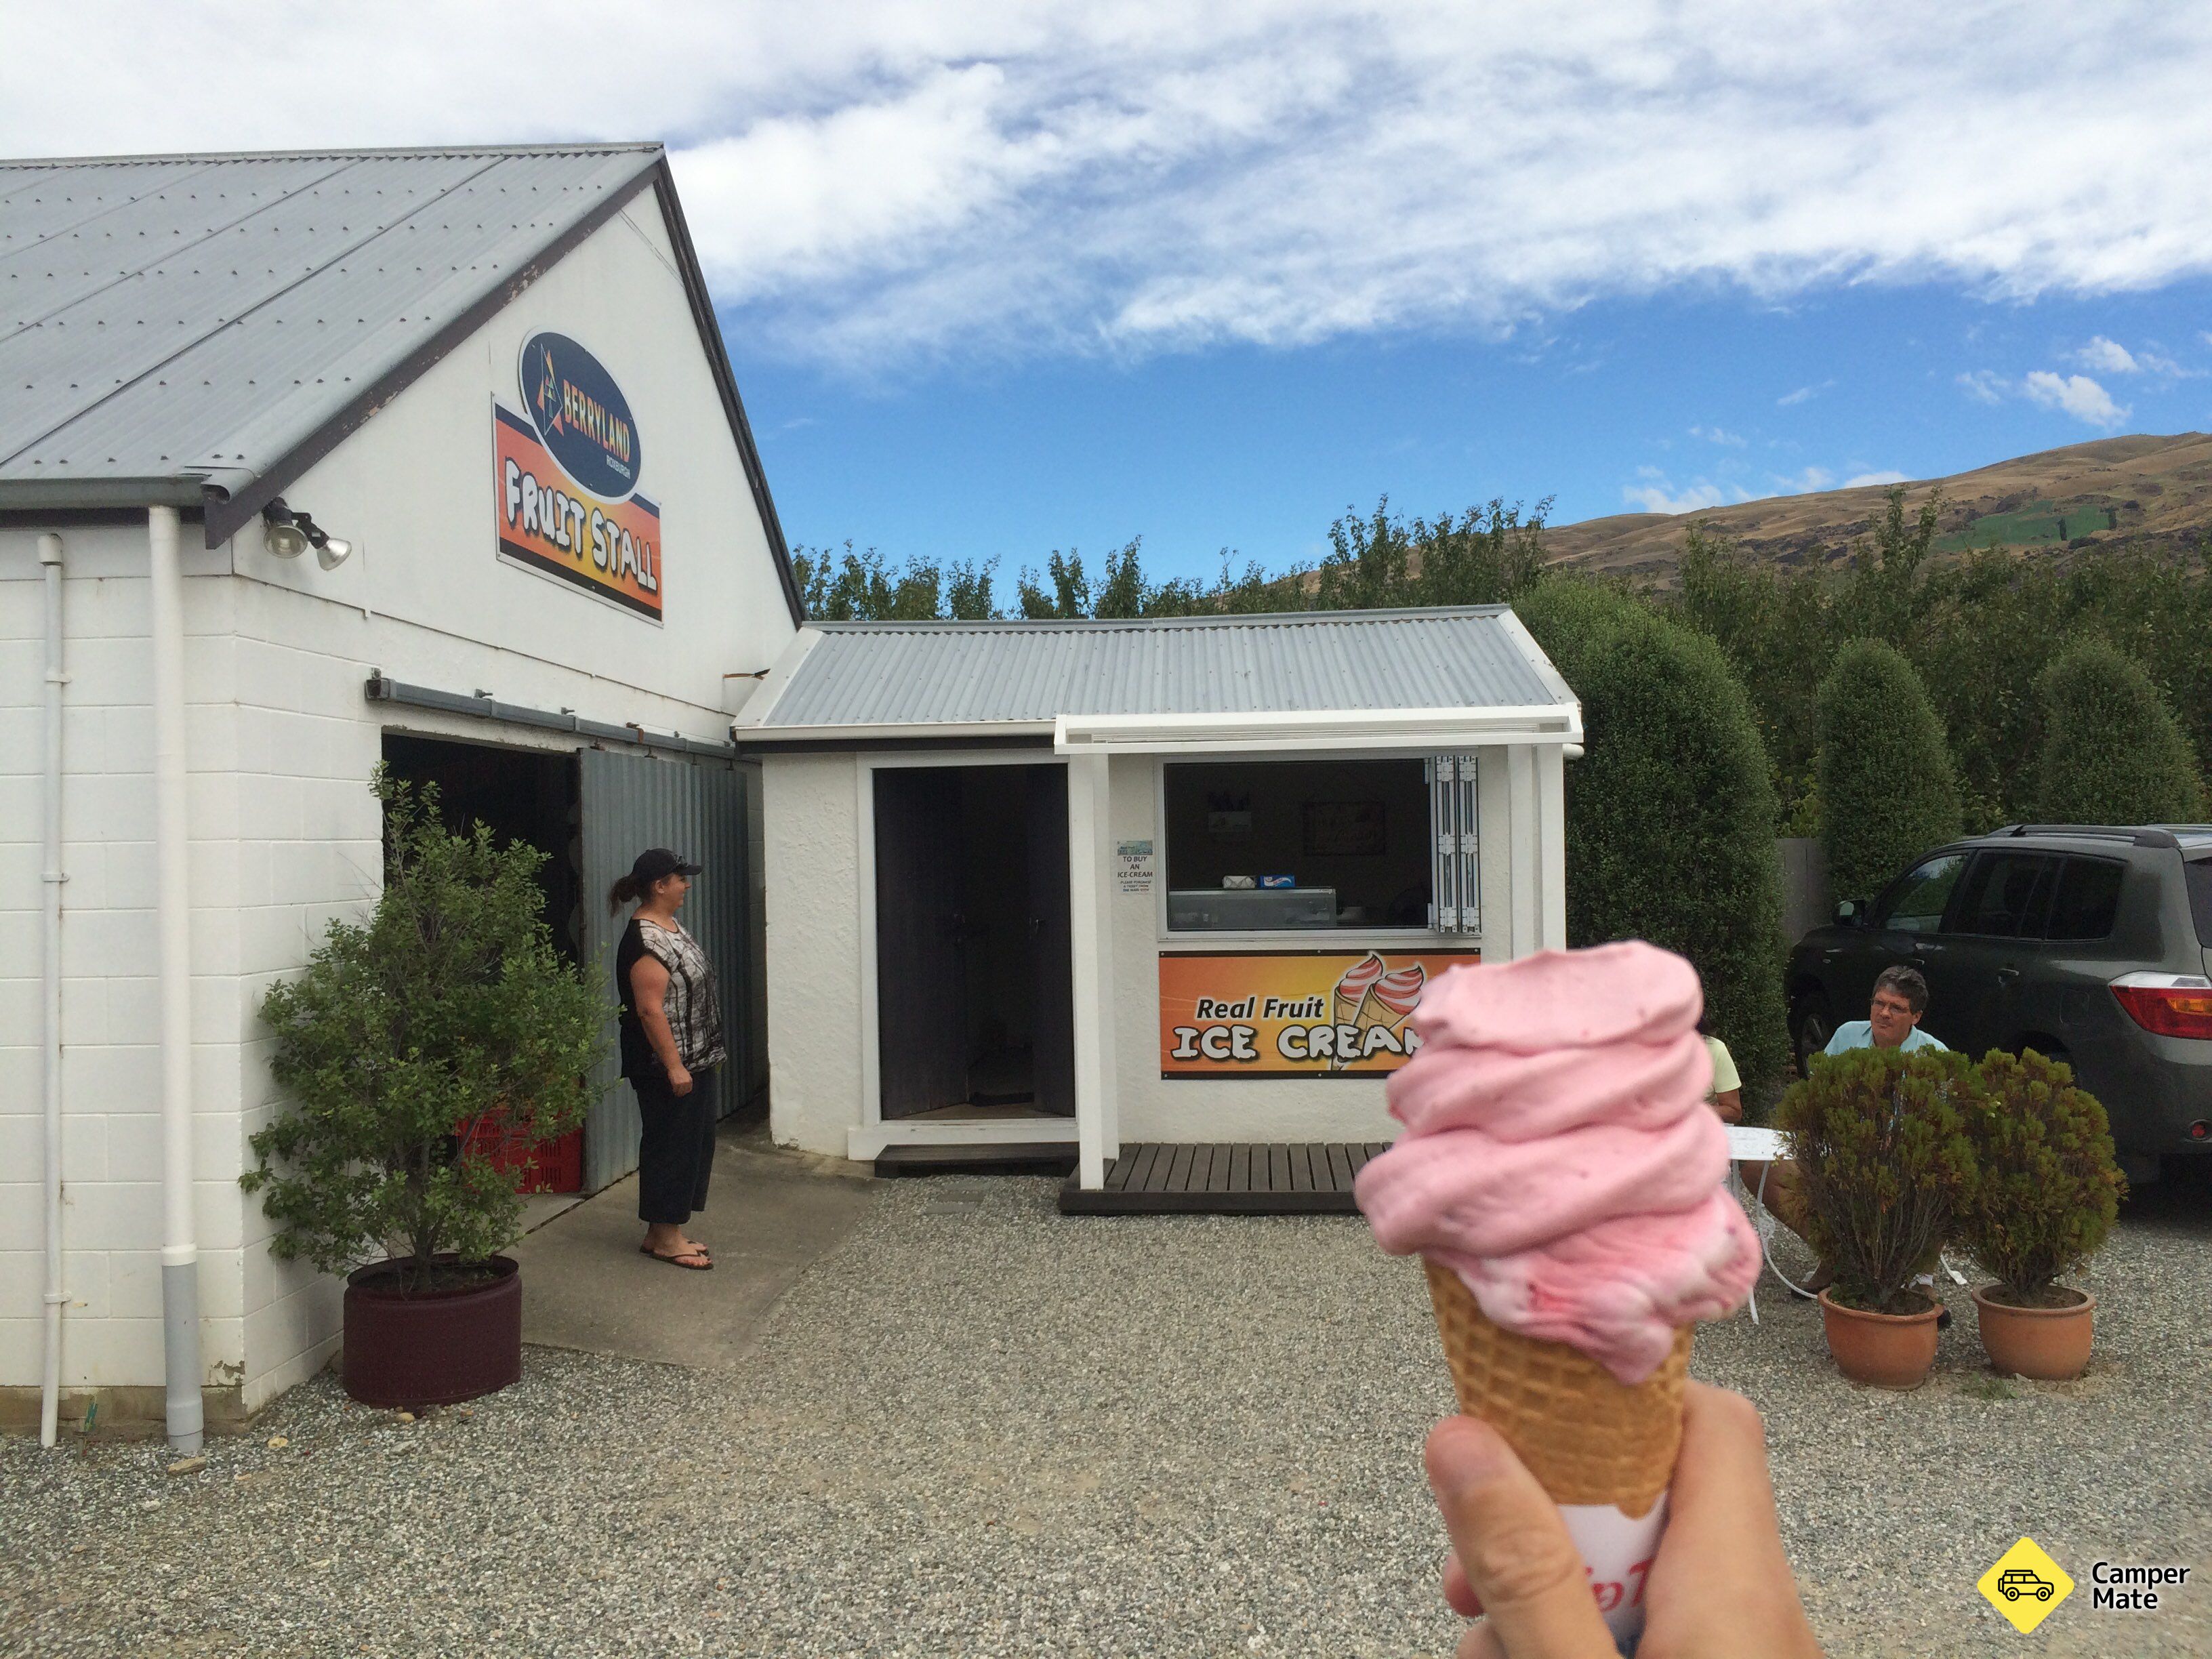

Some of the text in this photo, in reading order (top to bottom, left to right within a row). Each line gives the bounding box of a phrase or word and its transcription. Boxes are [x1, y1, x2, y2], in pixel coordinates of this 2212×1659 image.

[563, 378, 630, 463] BERRYLAND
[505, 456, 657, 592] FRUIT STALL
[1197, 997, 1324, 1019] Real Fruit
[1171, 1025, 1258, 1061] ICE
